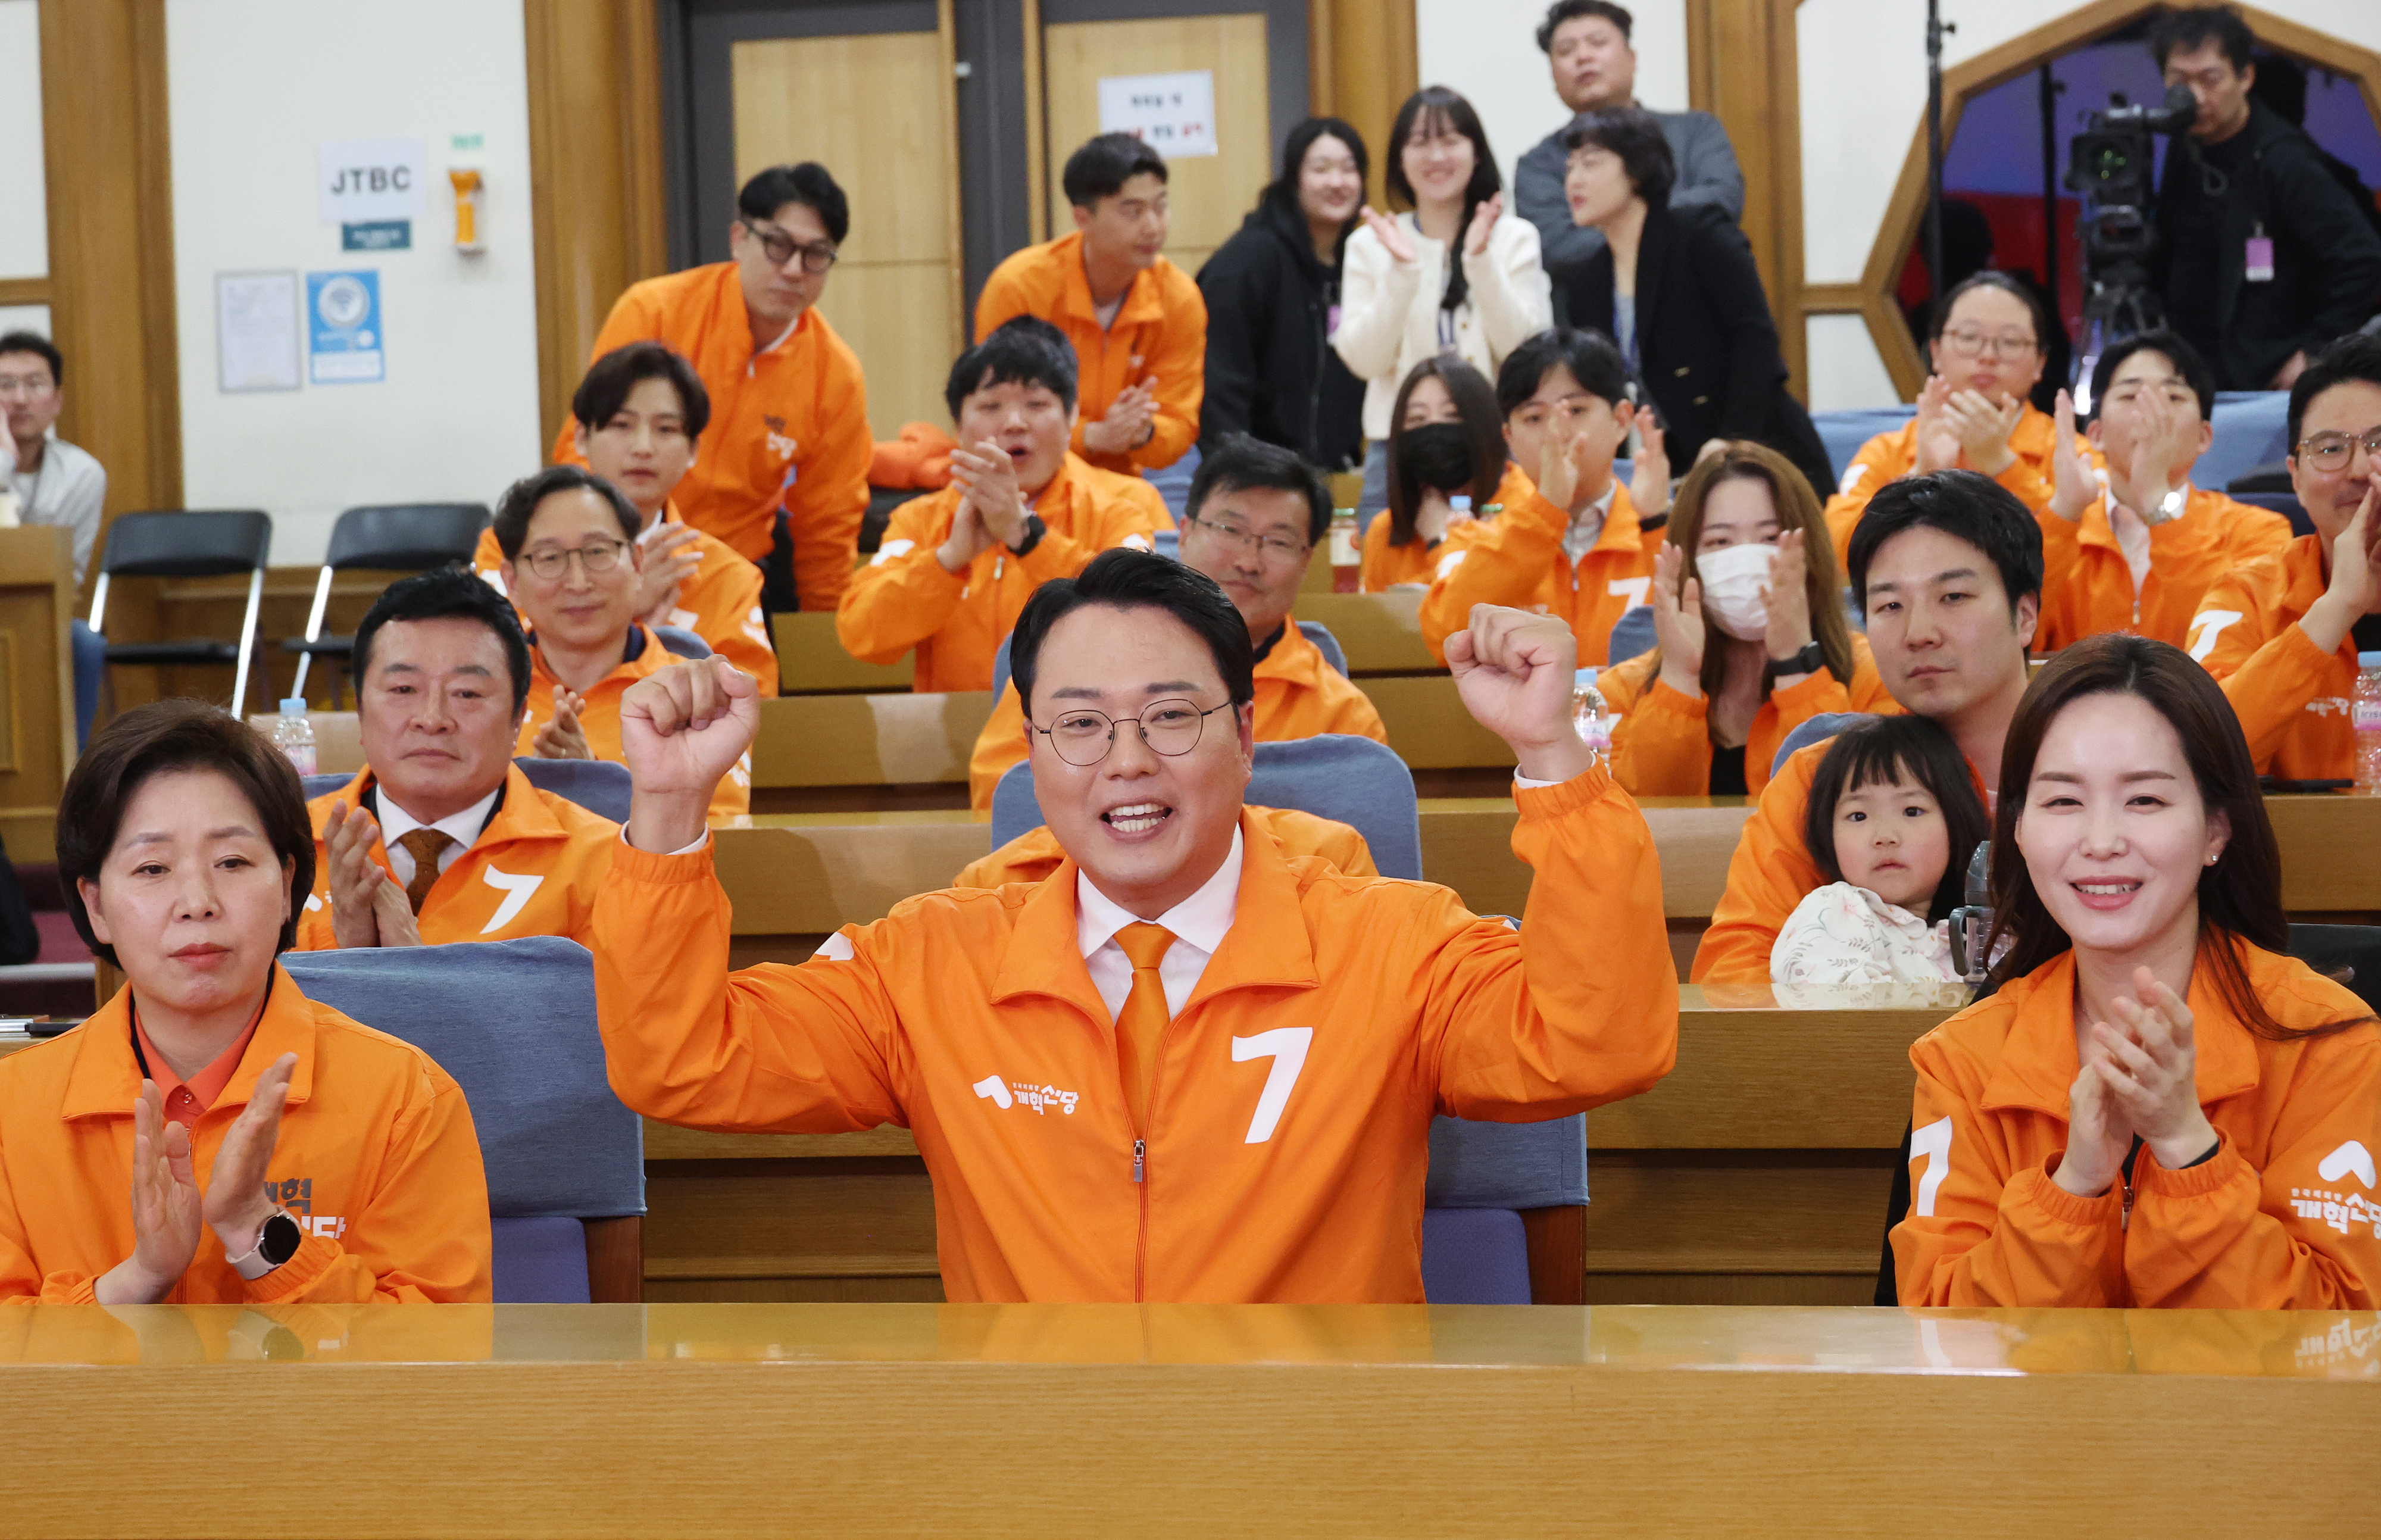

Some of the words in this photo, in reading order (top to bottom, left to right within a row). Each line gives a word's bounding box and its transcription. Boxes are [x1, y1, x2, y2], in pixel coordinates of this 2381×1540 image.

[331, 166, 411, 195] JTBC
[2189, 609, 2243, 664] 7
[480, 863, 544, 935] 7
[1014, 1084, 1079, 1116] 개혁신당
[1232, 1026, 1313, 1144] 7
[1908, 1115, 1952, 1217] 7
